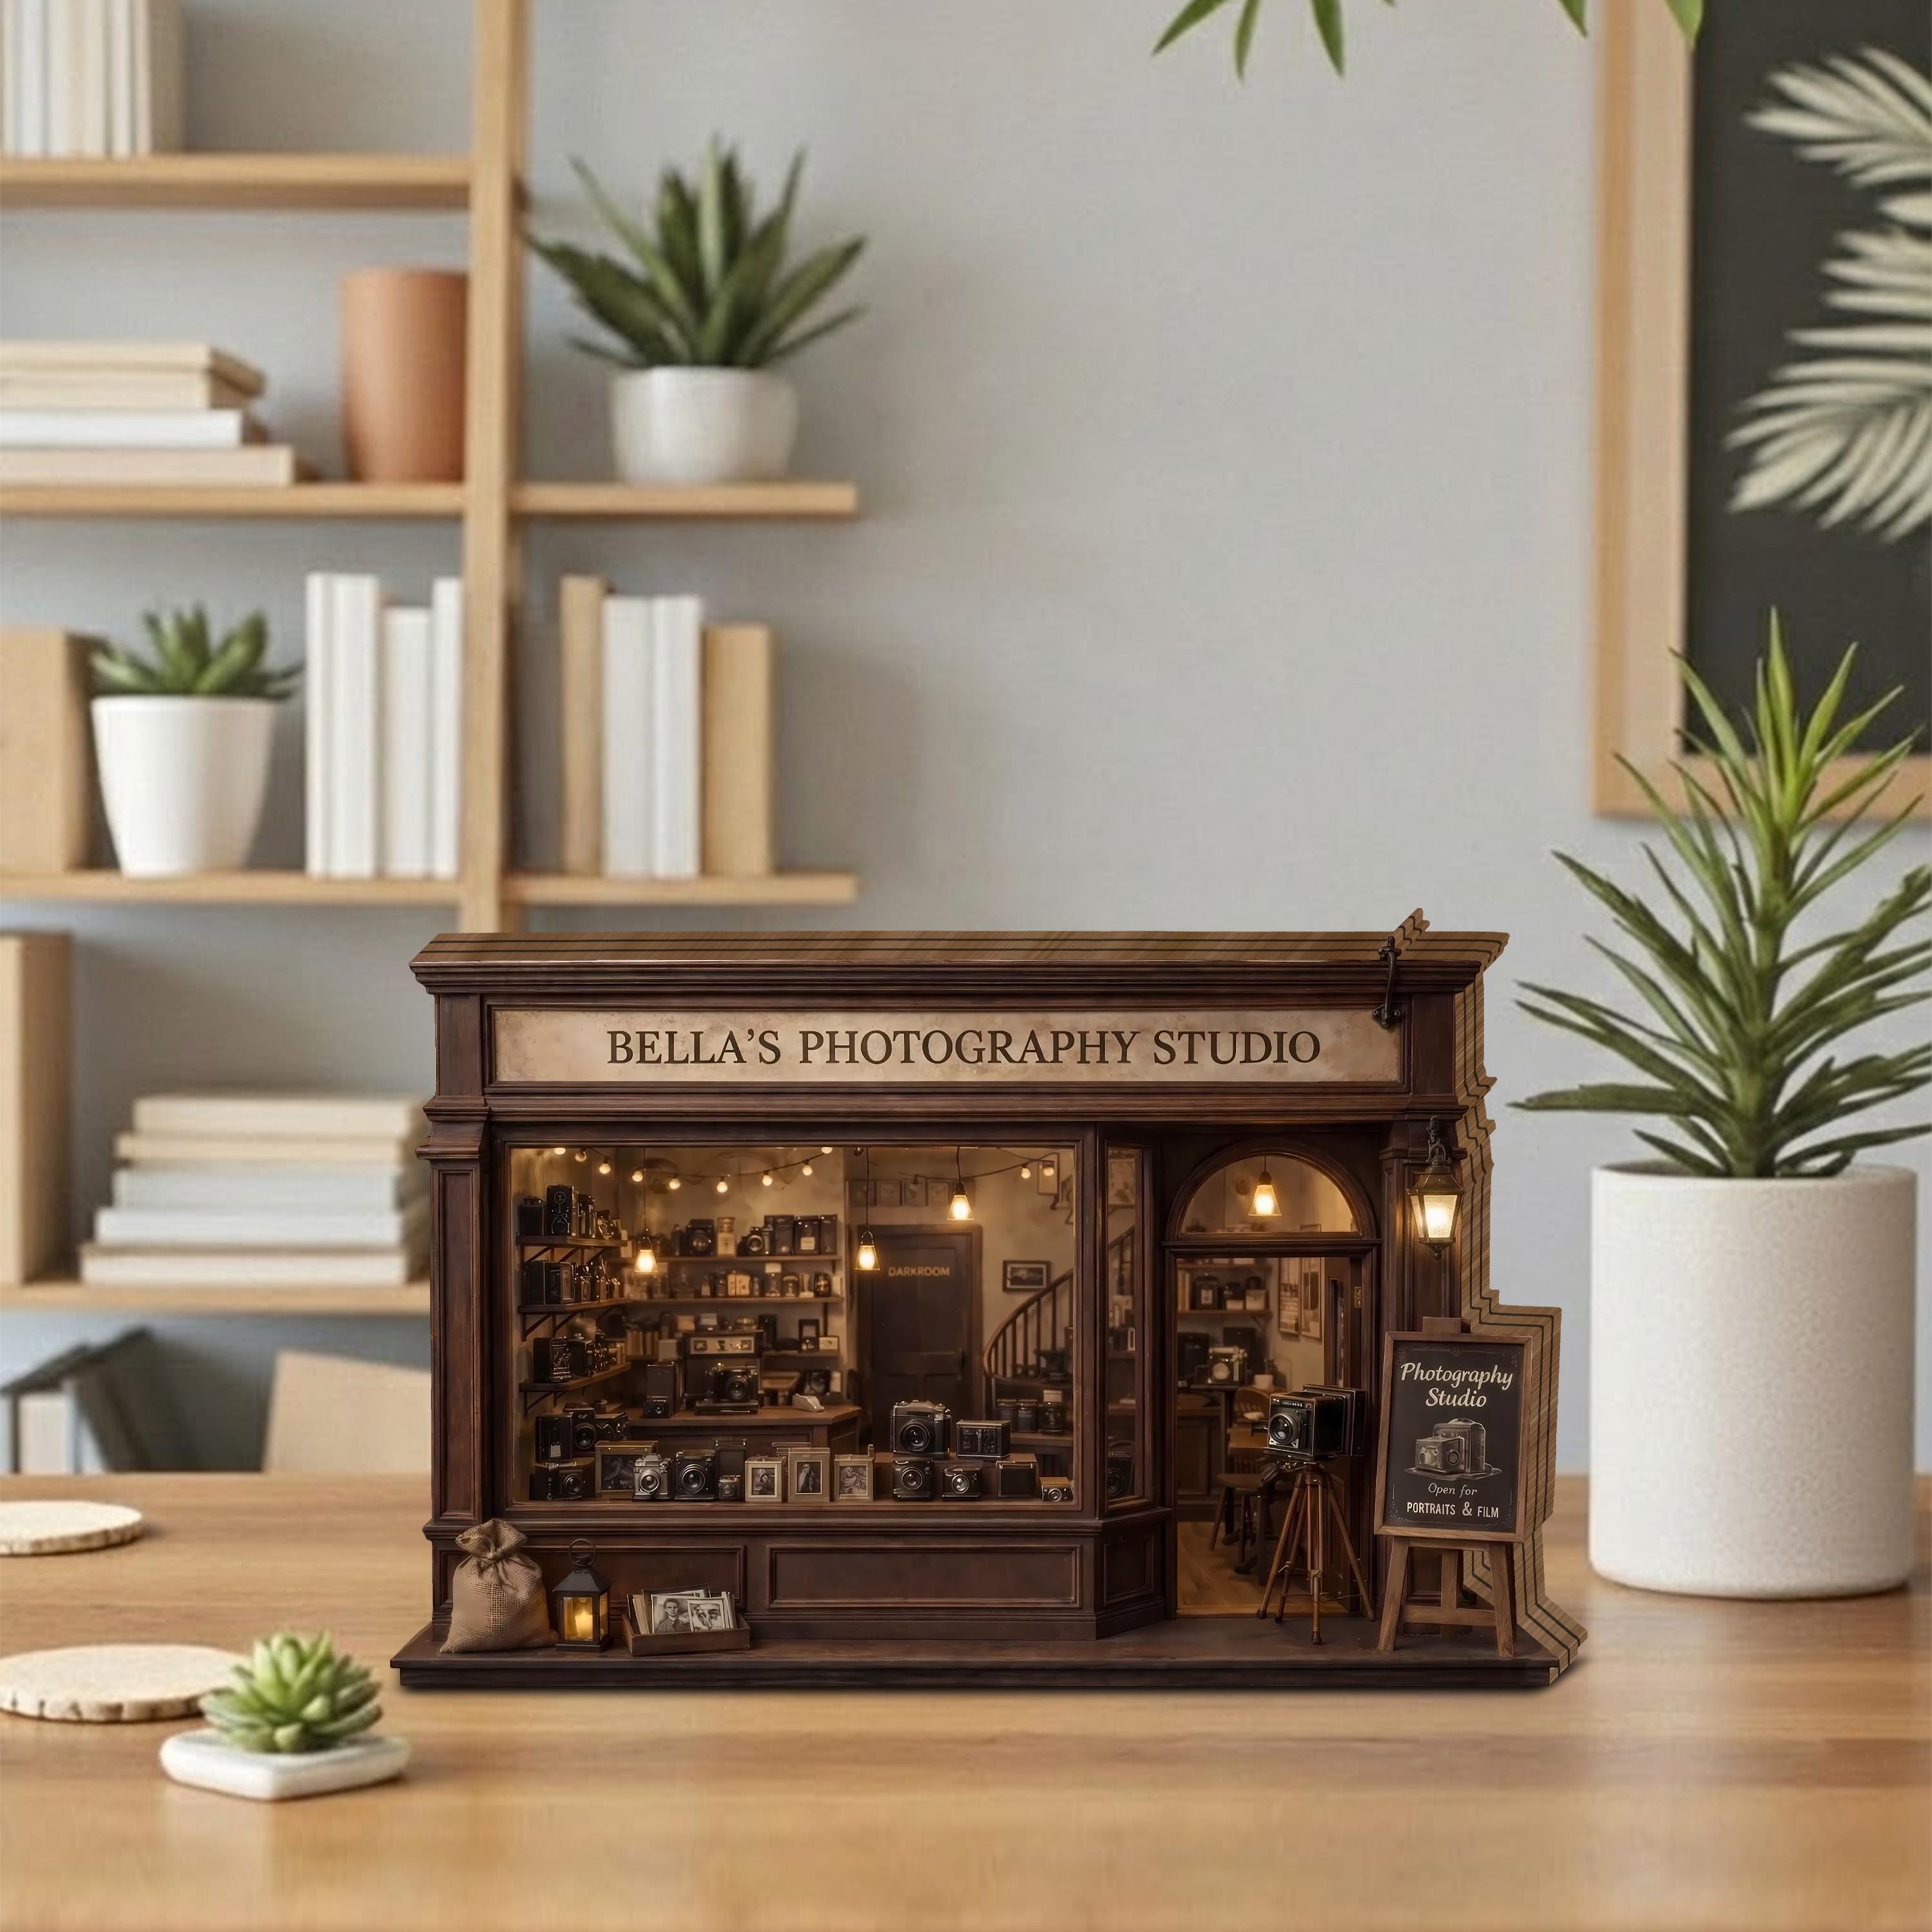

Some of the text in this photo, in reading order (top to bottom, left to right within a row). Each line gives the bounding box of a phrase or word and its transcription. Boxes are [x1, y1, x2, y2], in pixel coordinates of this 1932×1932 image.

[607, 1028, 1321, 1065] BELLA’S PHOTOGRAPHY STUDIO
[888, 1266, 951, 1276] DARKROOM
[1400, 1362, 1513, 1390] Photography
[1425, 1387, 1487, 1407] Studio
[1428, 1482, 1477, 1498] Open for
[1406, 1501, 1499, 1519] PORTRAITS & FILM
